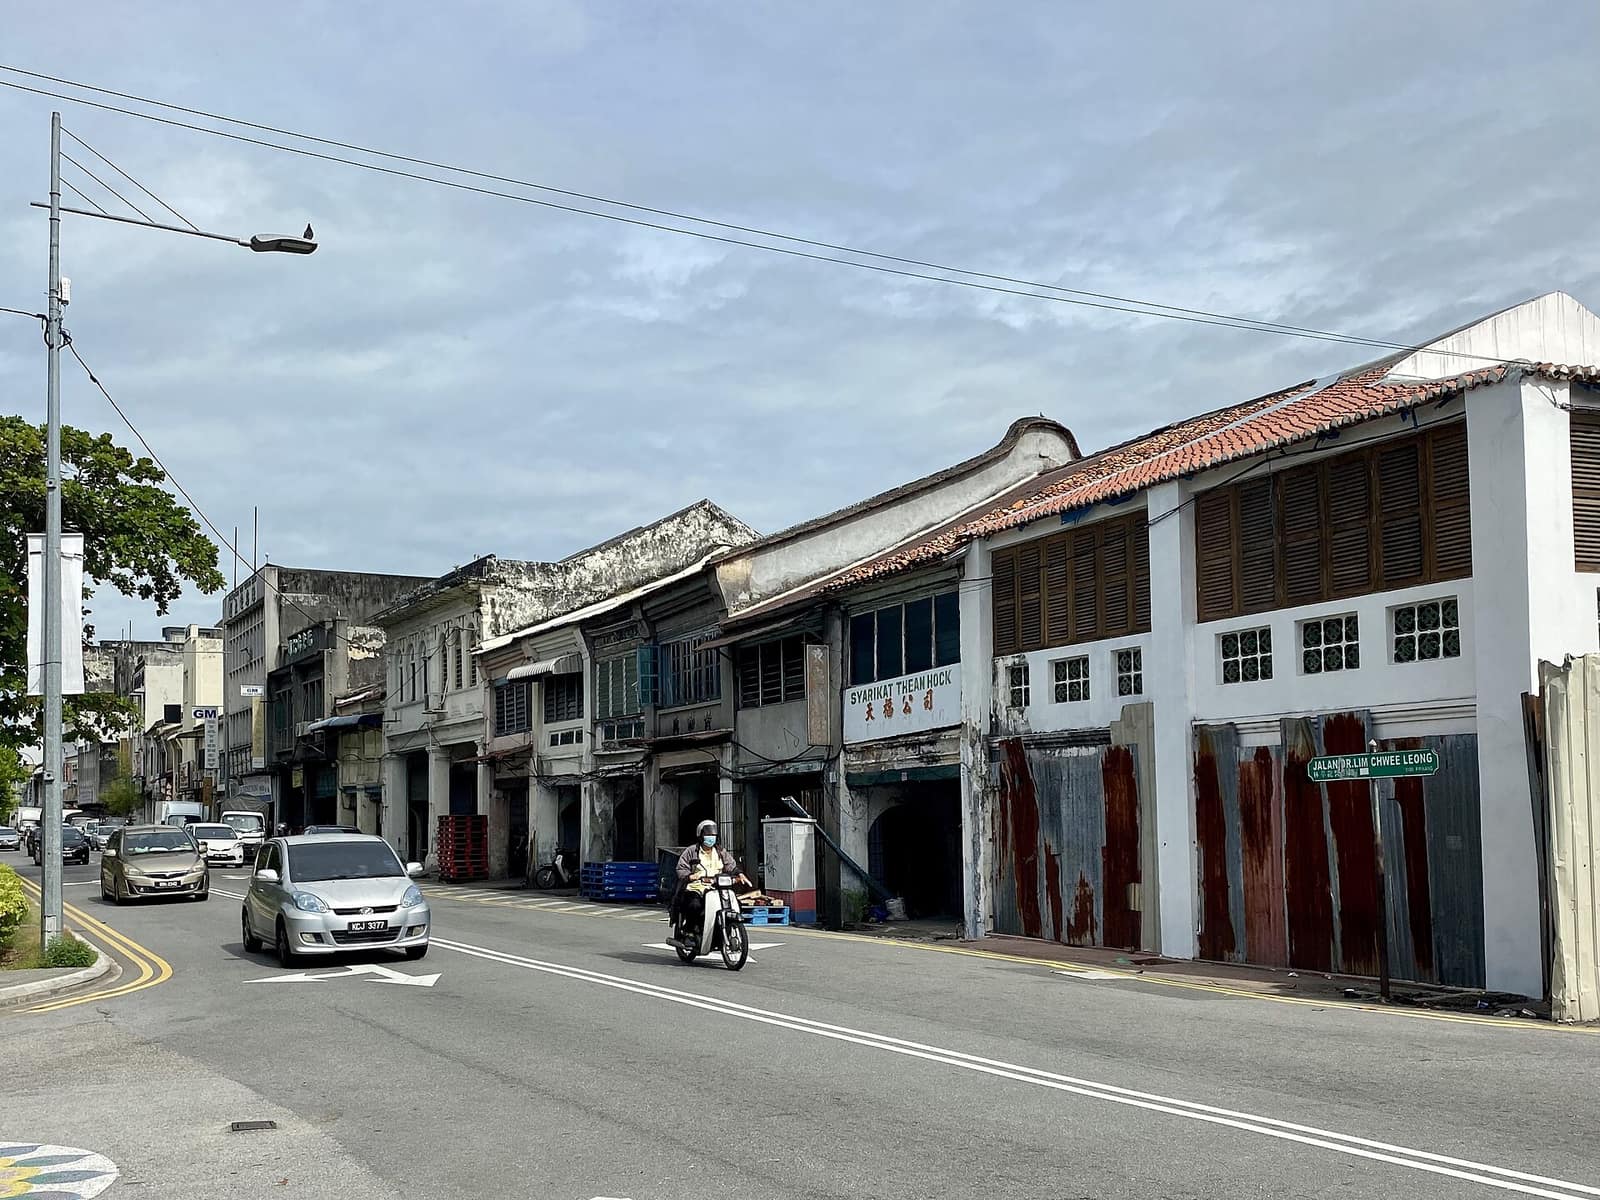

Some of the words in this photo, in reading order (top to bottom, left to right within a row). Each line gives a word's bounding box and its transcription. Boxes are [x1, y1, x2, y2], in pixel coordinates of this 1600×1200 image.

[851, 684, 893, 704] SYARIKAT
[896, 677, 925, 695] THEAN
[928, 670, 952, 688] HOCK
[193, 710, 217, 718] GM
[1313, 760, 1338, 770] JALAN
[1371, 754, 1400, 767] CHWEE
[1403, 753, 1433, 765] LEONG
